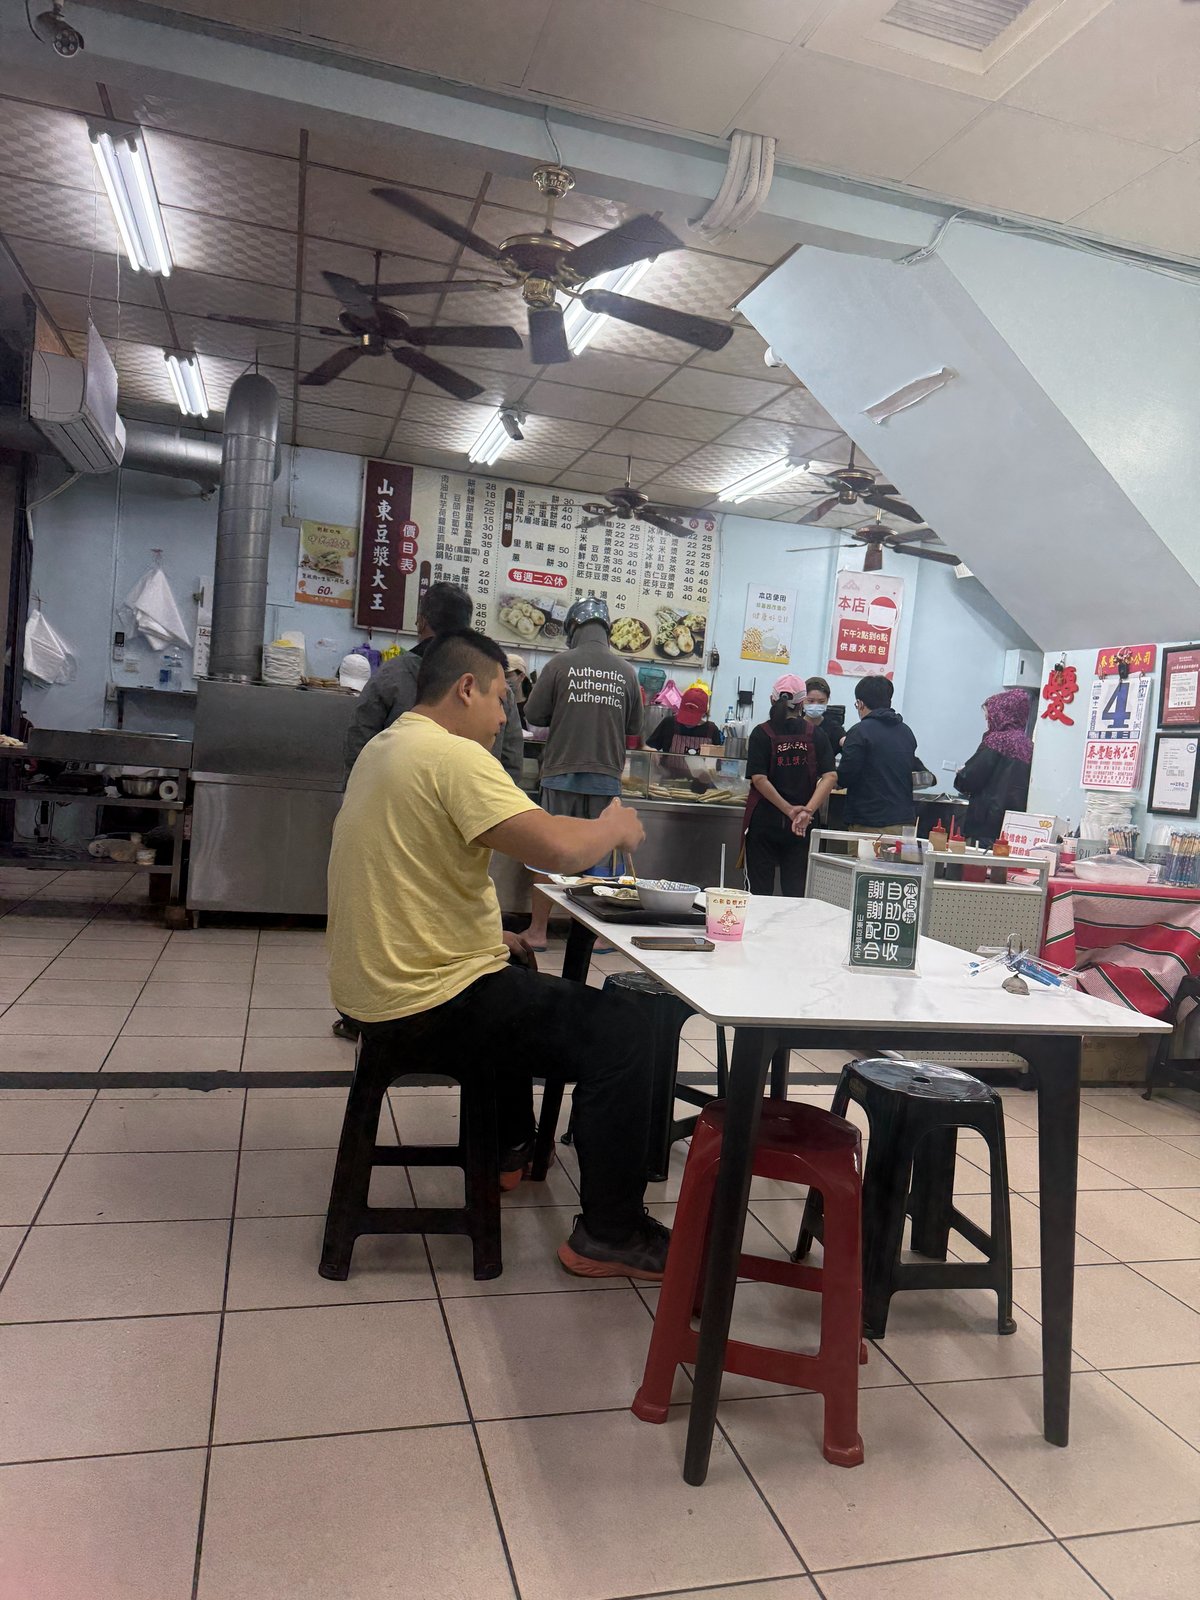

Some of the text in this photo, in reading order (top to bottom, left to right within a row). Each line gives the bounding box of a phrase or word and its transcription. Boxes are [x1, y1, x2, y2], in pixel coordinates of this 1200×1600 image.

[486, 491, 496, 499] 18
[485, 499, 495, 507] 25
[484, 507, 494, 515] 25
[484, 516, 494, 524] 15
[515, 515, 557, 528] 九層塔蛋餅
[482, 524, 493, 532] 30
[482, 532, 493, 540] 30
[579, 534, 611, 546] 米漿
[370, 478, 394, 610] 山東豆漿大王
[400, 525, 417, 571] 價目表
[578, 552, 610, 564] 鮮奶茶
[434, 563, 490, 578] 燒餅 22
[577, 561, 609, 573] 杏仁豆漿
[434, 572, 489, 586] 燒餅油條 40
[513, 571, 564, 586] 每週二公休
[576, 571, 636, 585] 胚芽豆漿 35 40
[644, 570, 676, 582] 杏仁豆漿
[643, 579, 675, 591] 胚芽豆漿
[574, 587, 607, 599] 酸辣湯
[642, 587, 674, 599] 冰牛奶
[758, 592, 787, 602] 本店使用
[838, 596, 867, 613] 本店
[842, 628, 888, 642] 下午2點到6點
[840, 642, 886, 656] 供應水煎包
[1102, 682, 1131, 729] 4
[863, 880, 885, 960] 謝謝配合
[882, 881, 902, 961] 自助回收
[854, 914, 865, 959] 山東豆漿大王
